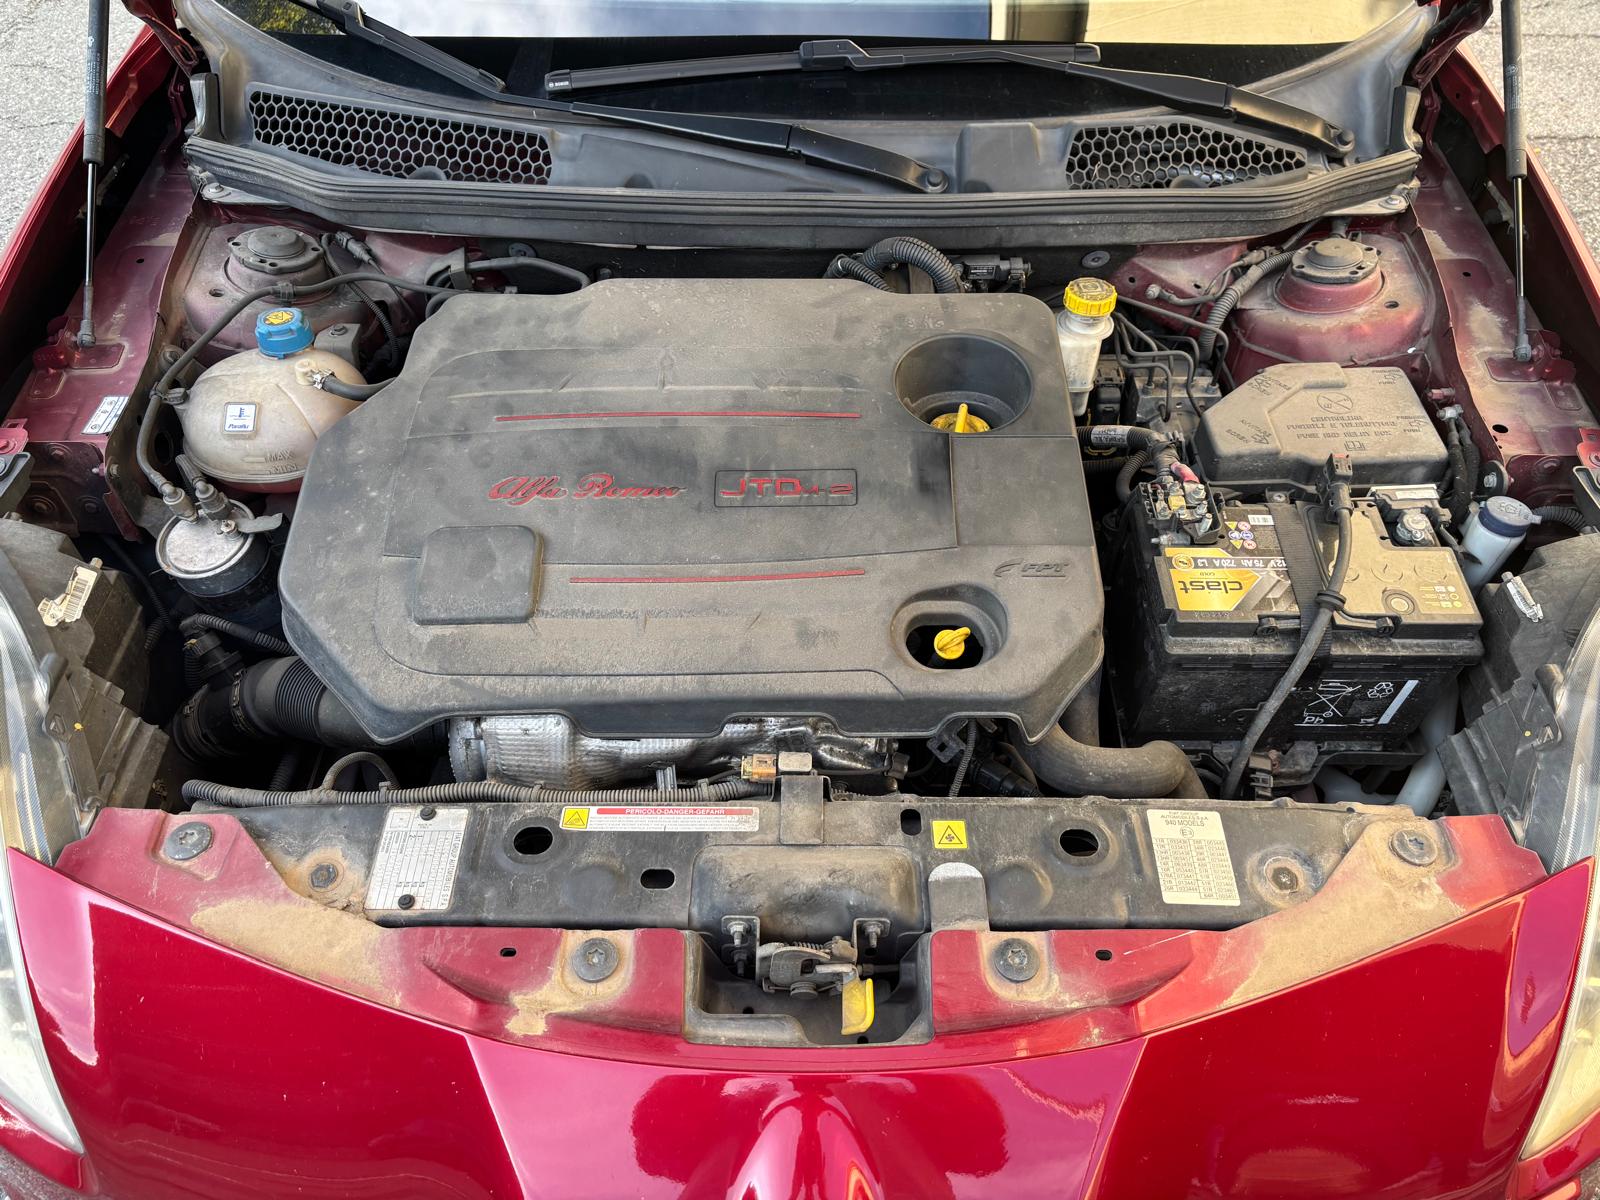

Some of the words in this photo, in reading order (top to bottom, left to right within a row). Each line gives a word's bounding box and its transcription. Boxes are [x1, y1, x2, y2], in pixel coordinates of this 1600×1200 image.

[265, 451, 295, 463] MAX
[488, 475, 568, 506] Alfa
[573, 472, 687, 500] Romeo
[1178, 580, 1243, 594] clast
